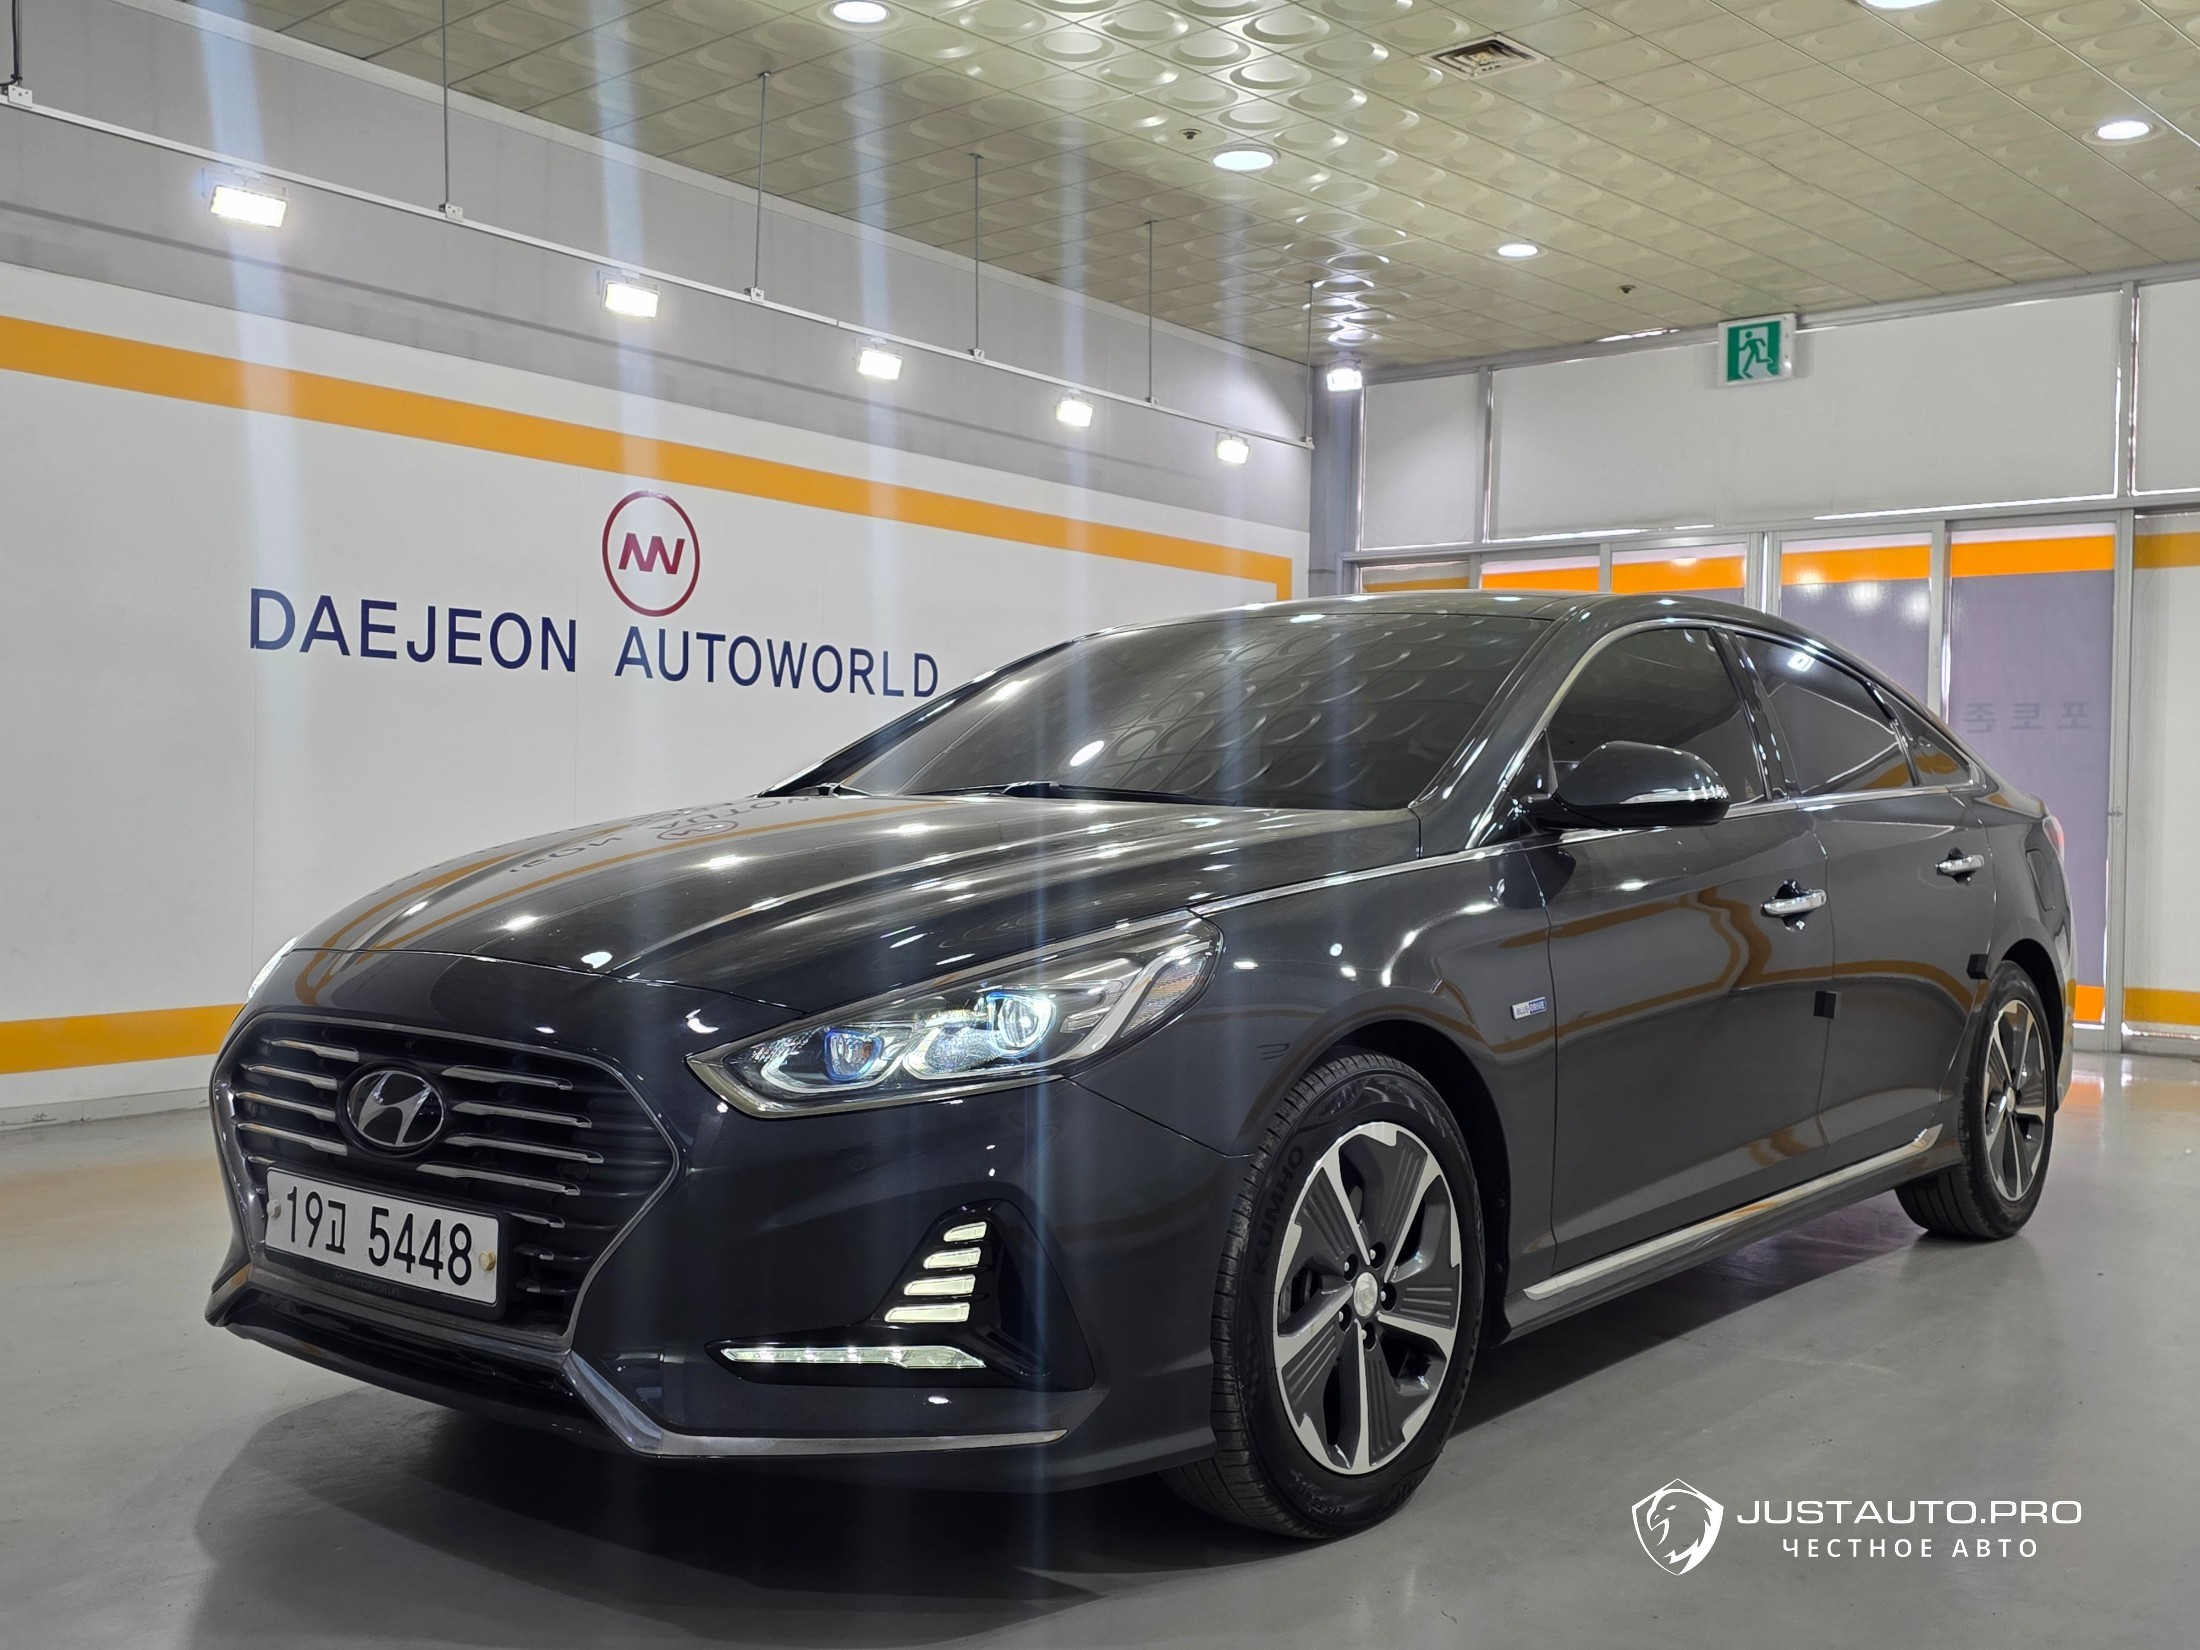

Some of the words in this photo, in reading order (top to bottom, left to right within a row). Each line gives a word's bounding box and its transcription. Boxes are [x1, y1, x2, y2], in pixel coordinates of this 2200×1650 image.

[250, 588, 577, 673] DAEJEON
[615, 626, 939, 697] AUTOWORLD
[368, 1206, 472, 1286] 5448
[1253, 1145, 1304, 1275] KUMHO
